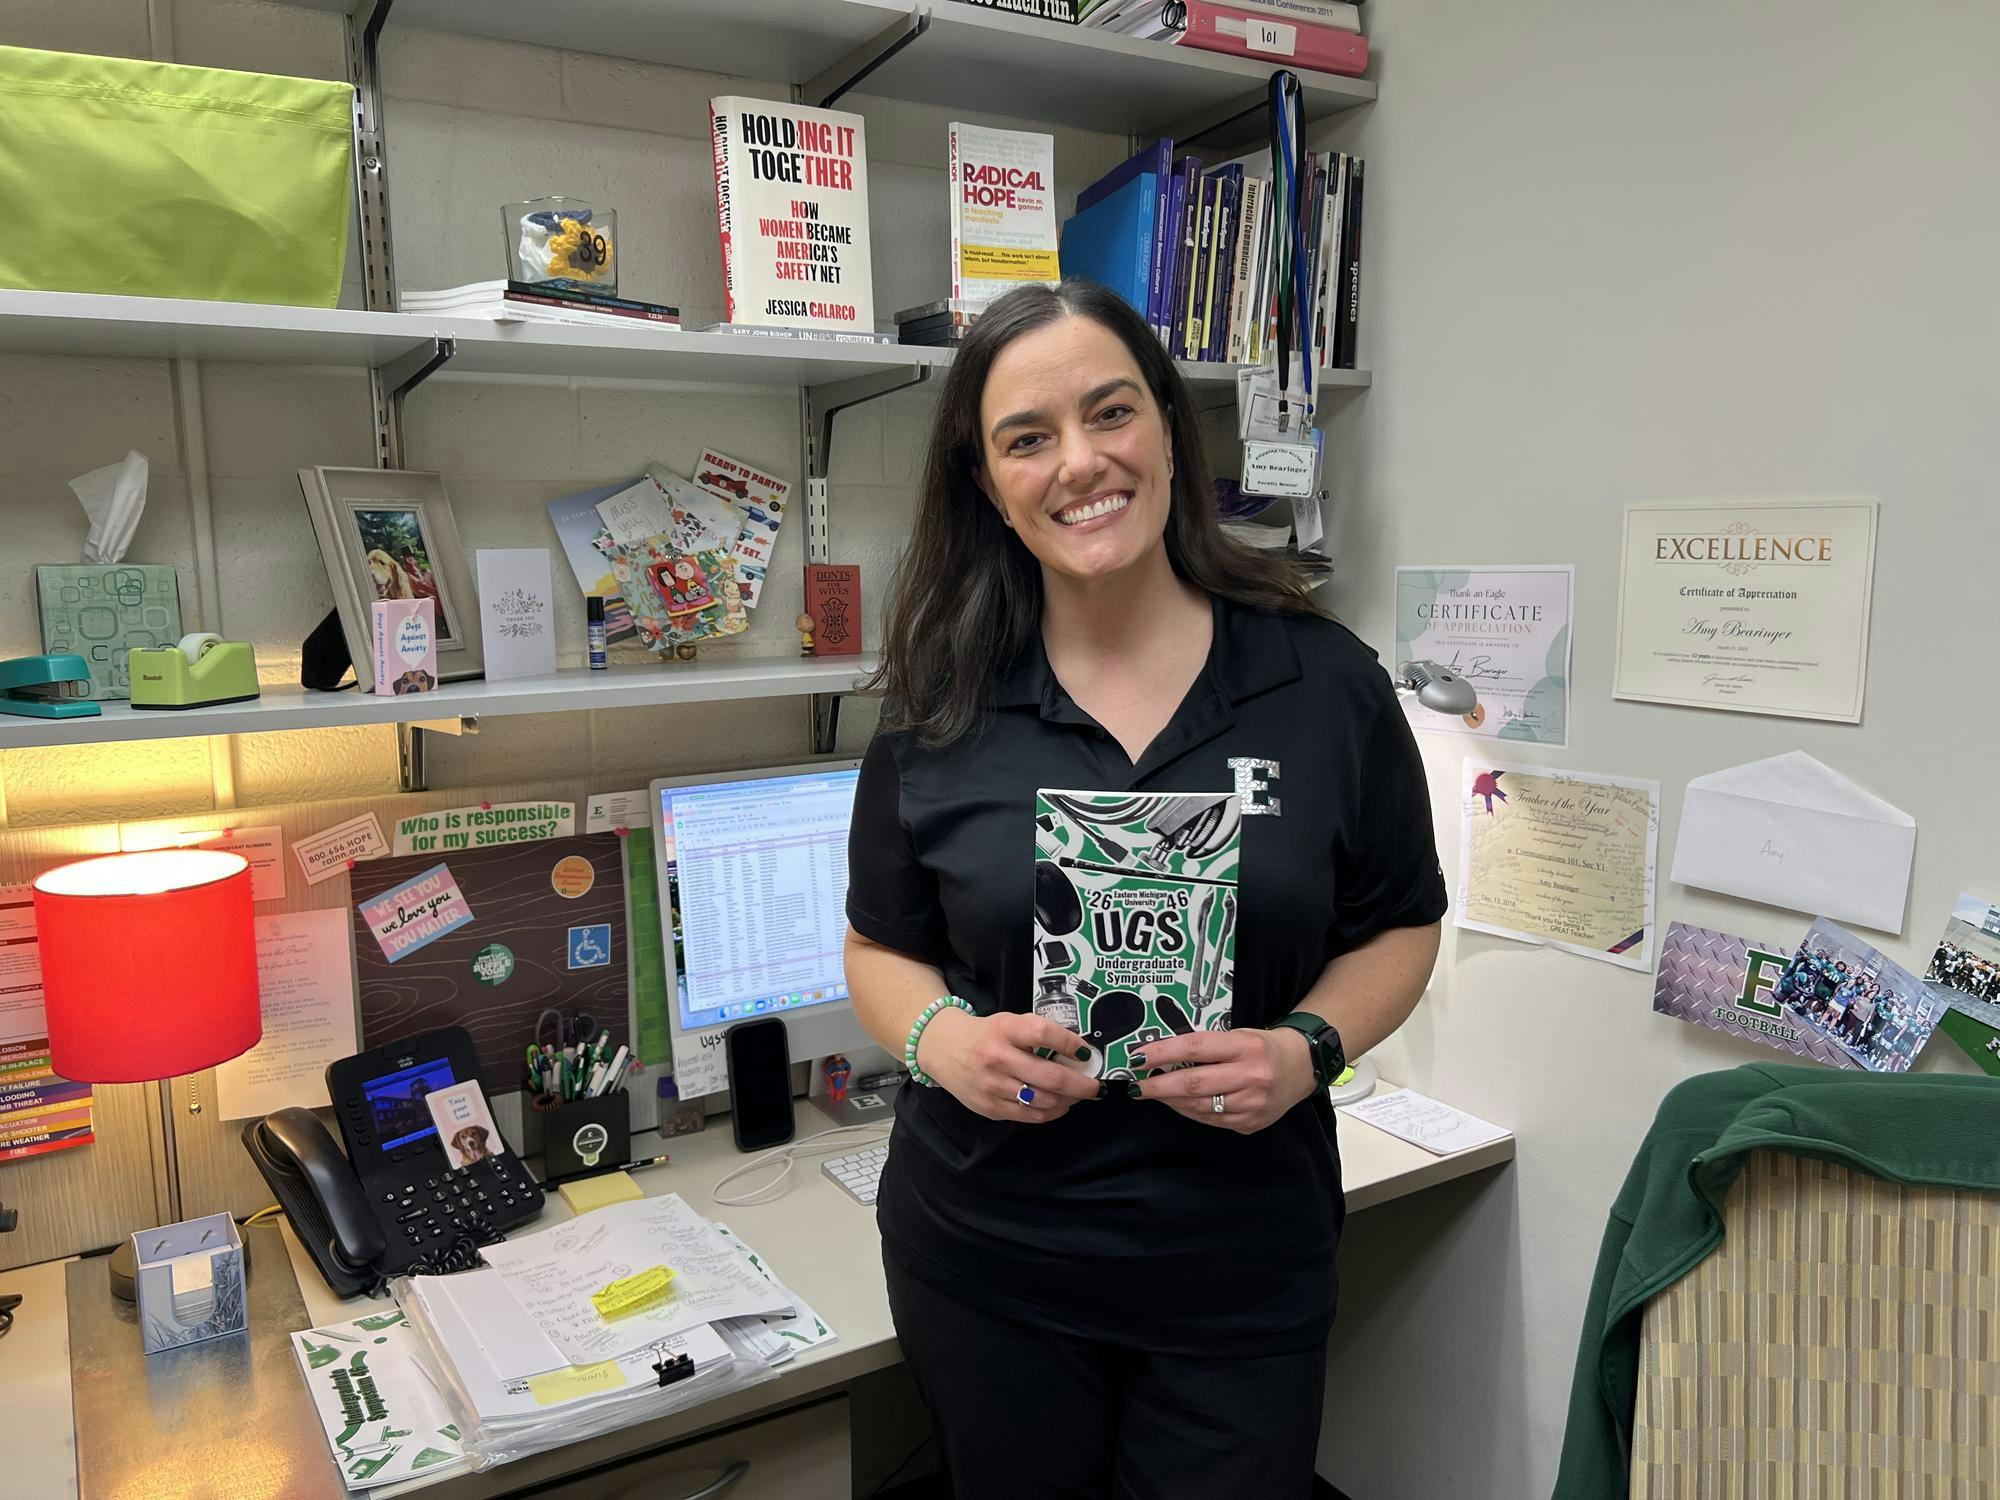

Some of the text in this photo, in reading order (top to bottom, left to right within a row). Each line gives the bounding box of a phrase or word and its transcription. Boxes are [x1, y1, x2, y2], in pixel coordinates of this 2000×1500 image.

[1276, 1, 1333, 17] Conference 2011
[741, 112, 855, 157] HOLDING IT
[749, 148, 853, 191] TOGETHER
[963, 162, 1045, 191] RADICAL
[964, 184, 1016, 208] HOPE
[1017, 196, 1034, 204] kevin
[1018, 203, 1043, 211] gannon
[790, 200, 818, 220] HOW
[964, 215, 1000, 224] manifesto
[971, 207, 1003, 218] teaching
[1158, 193, 1167, 241] Communication
[759, 218, 851, 244] WOMEN BECAME
[1240, 184, 1257, 280] Interracial Communication
[580, 230, 606, 266] 39
[777, 241, 838, 263] AMERICA'S
[775, 261, 841, 284] SAFETY NET
[1154, 268, 1162, 294] Cultures
[1350, 261, 1359, 323] speeches
[766, 299, 855, 321] JESSICA CALARCO
[704, 453, 750, 479] READY TO
[1252, 463, 1308, 473] Amy Bearinger
[1656, 537, 1832, 561] EXCELLENCE
[1450, 588, 1470, 598] Thank
[1485, 589, 1506, 600] Eagle
[1679, 586, 1797, 600] Certificate of Appreciation
[1417, 604, 1542, 621] CERTIFICATE
[401, 634, 426, 643] Against
[1425, 621, 1531, 634] OF APPRECIATION
[1682, 617, 1792, 645] Amy Bearinger
[401, 645, 427, 653] Anxiety
[1228, 757, 1281, 817] E
[594, 806, 602, 815] E
[1514, 788, 1549, 806] Teacher
[1561, 799, 1575, 809] the
[1578, 798, 1611, 816] Year
[401, 803, 570, 835] Who is responsible
[412, 820, 558, 851] for my success?
[309, 832, 373, 864] 800.656.HOPE
[322, 845, 366, 867] rainn.org
[1515, 848, 1566, 864] Communications
[1760, 839, 1784, 864] Amy
[1539, 880, 1551, 888] Amy
[373, 875, 441, 917] WE SEE YOU
[1139, 891, 1167, 899] Michigan
[1167, 891, 1189, 909] 46
[382, 892, 452, 934] we love you
[1525, 912, 1543, 922] Thank
[1544, 917, 1553, 925] you
[1563, 921, 1580, 931] being
[389, 909, 461, 951] YOU MATTER
[1094, 910, 1184, 953] UGS
[1550, 926, 1594, 941] GREAT Teacher!
[1097, 957, 1184, 971] Undergraduate
[1107, 972, 1173, 985] Symposium
[1716, 1008, 1800, 1042] FOOTBALL
[8, 1080, 41, 1090] FAILURE
[14, 1098, 43, 1108] THREAT
[13, 1133, 50, 1144] WEATHER
[331, 1368, 366, 1427] Undergraduate
[357, 1376, 389, 1421] Symposium
